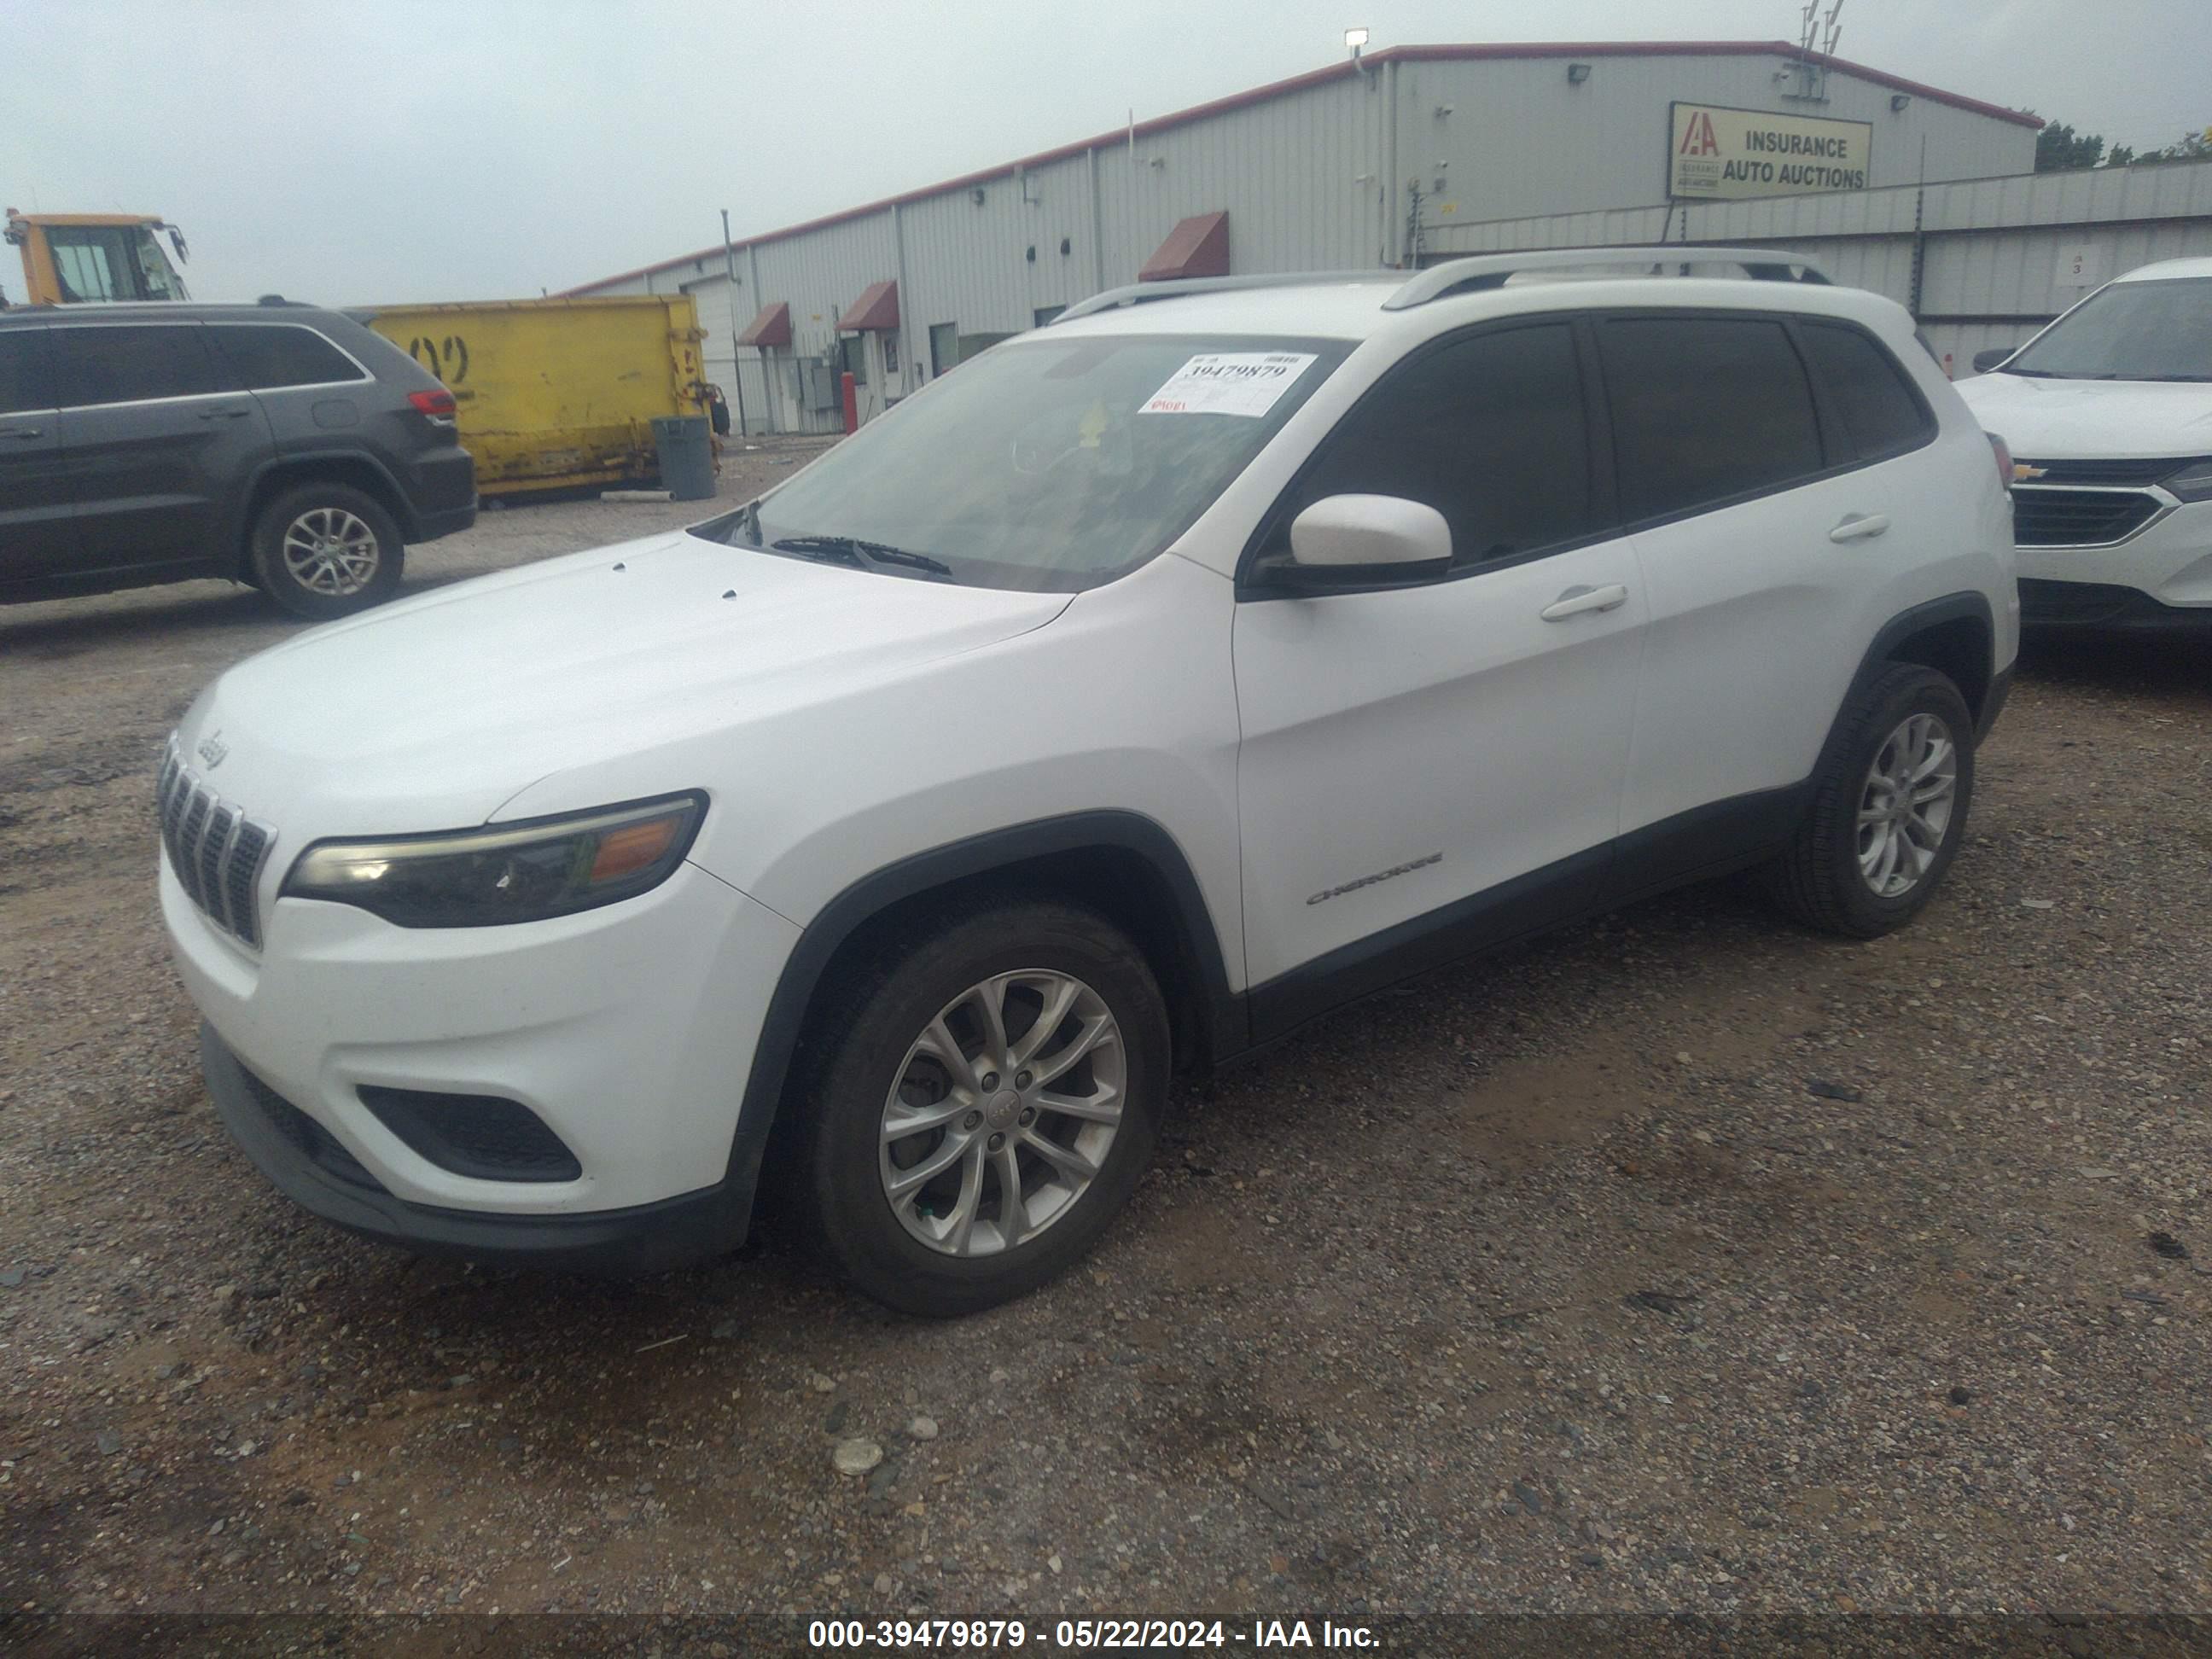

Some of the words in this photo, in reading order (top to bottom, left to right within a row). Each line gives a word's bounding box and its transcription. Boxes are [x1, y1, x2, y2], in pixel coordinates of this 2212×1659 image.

[1746, 131, 1847, 159] INSURANCE
[1722, 160, 1774, 183] AUTO
[1778, 164, 1864, 189] AUCTIONS
[1184, 364, 1288, 377] 39479879
[1307, 852, 1443, 905] CHEROKEE
